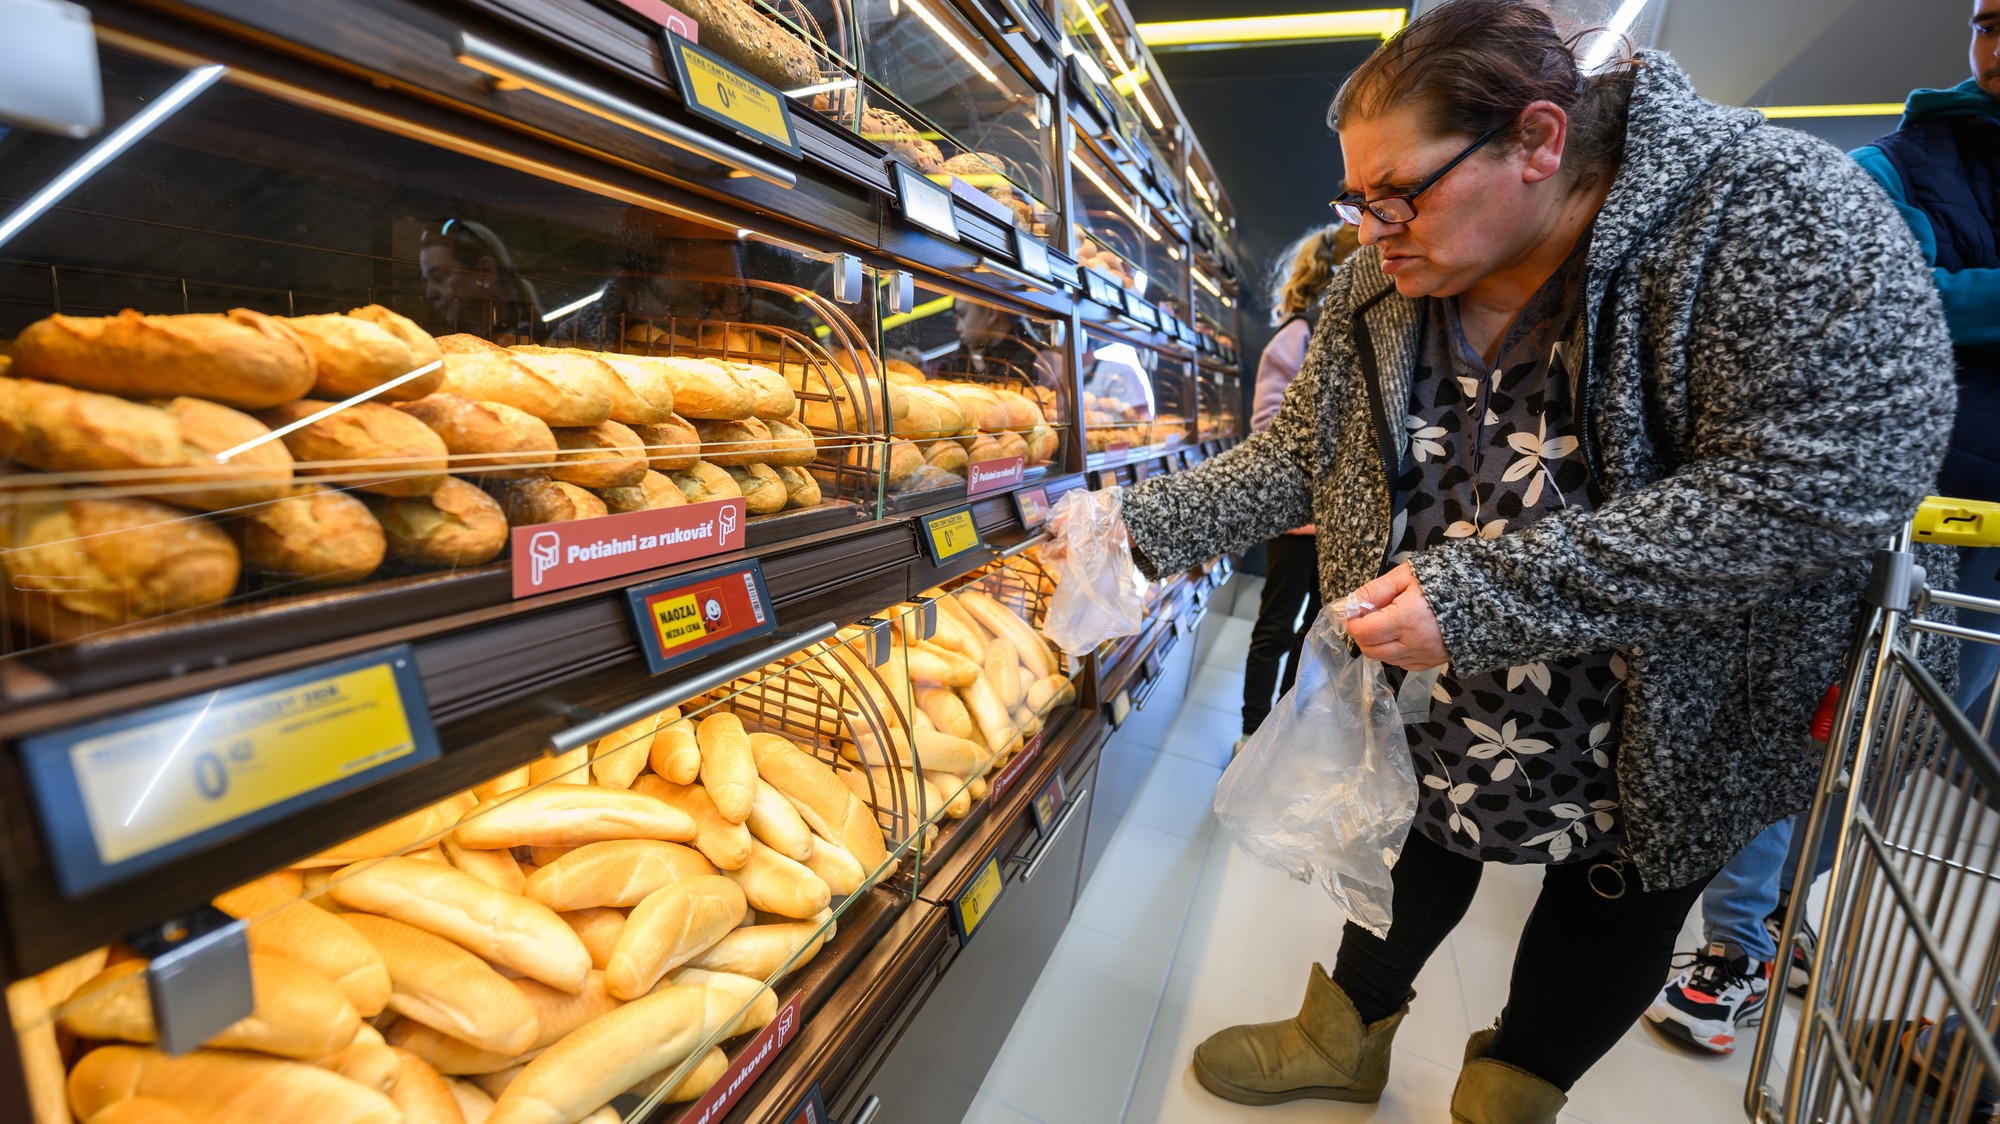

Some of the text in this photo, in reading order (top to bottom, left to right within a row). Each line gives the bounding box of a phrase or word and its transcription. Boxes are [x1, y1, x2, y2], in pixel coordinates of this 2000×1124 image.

[717, 82, 730, 108] 0
[566, 519, 713, 564] Potiahni za rukoväť
[944, 530, 952, 547] 0
[659, 603, 697, 625] NAOZAJ
[686, 622, 702, 634] CENA
[192, 750, 228, 801] 0
[972, 897, 979, 915] 0
[711, 1033, 774, 1116] za rukoväť
